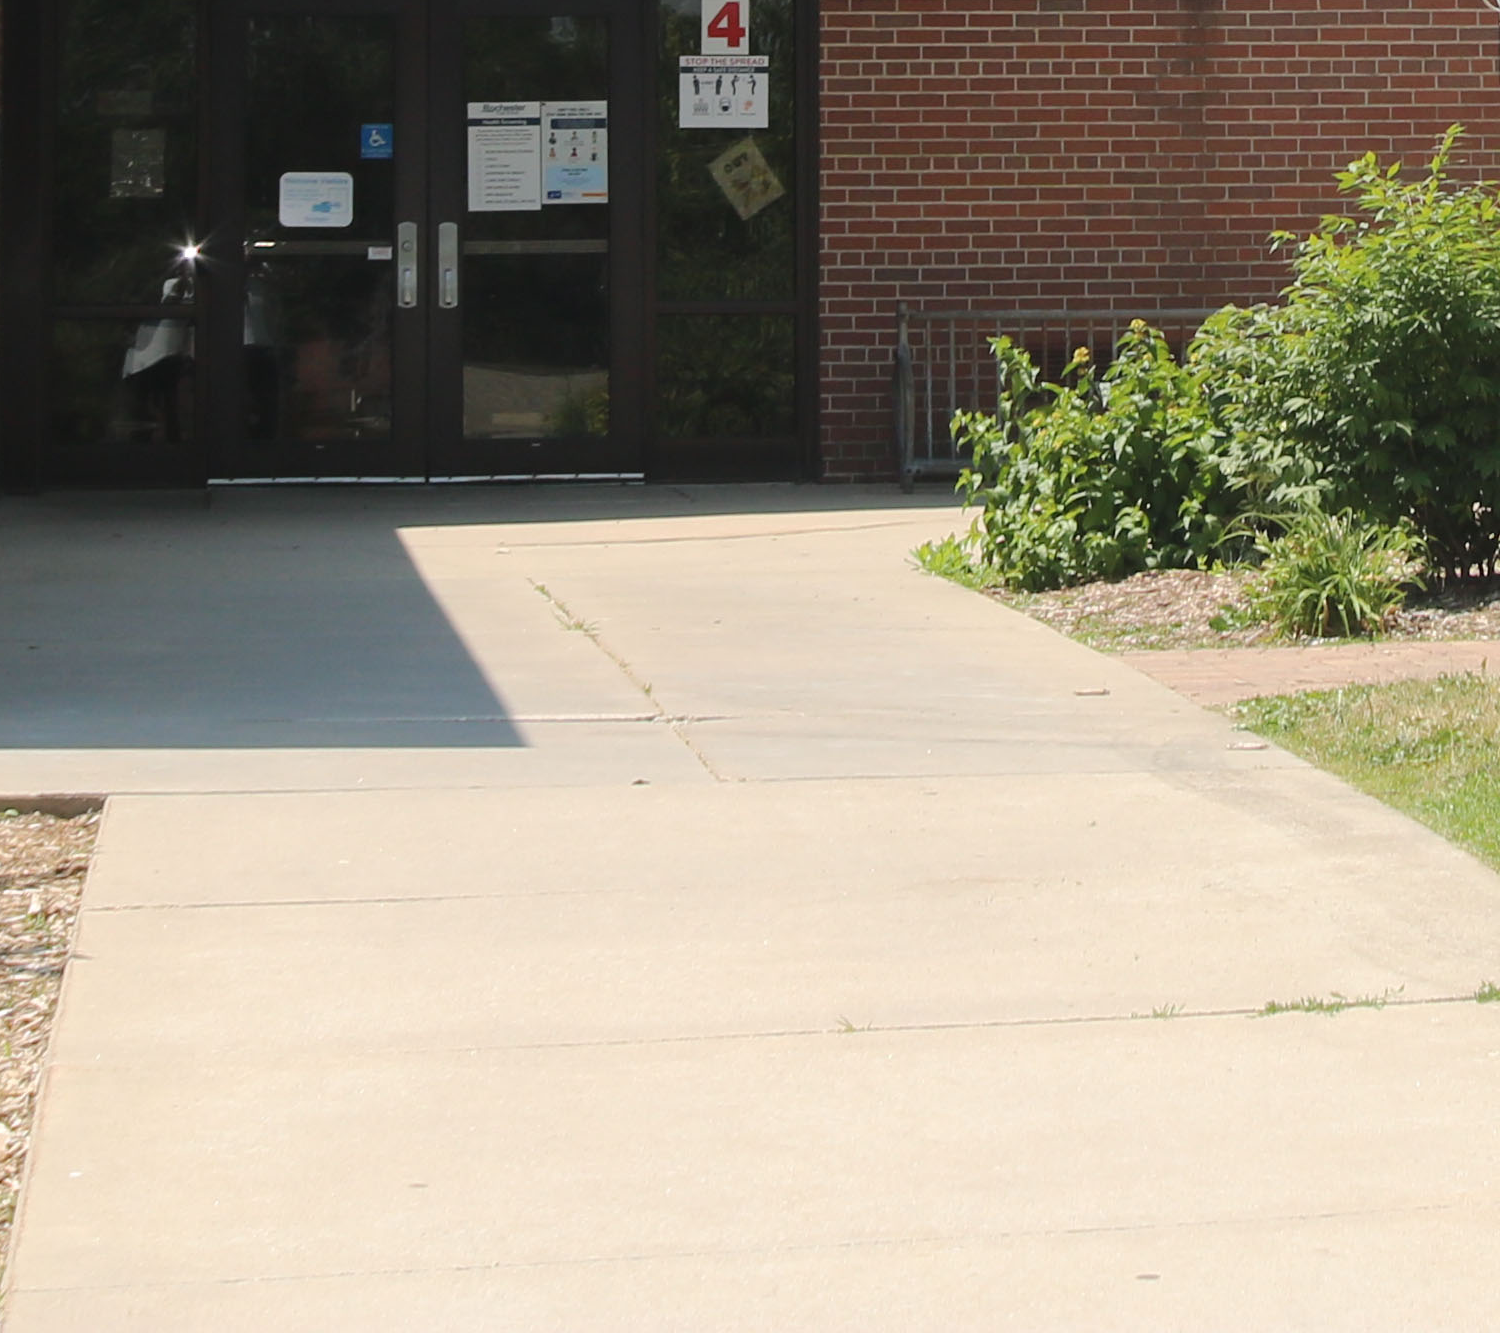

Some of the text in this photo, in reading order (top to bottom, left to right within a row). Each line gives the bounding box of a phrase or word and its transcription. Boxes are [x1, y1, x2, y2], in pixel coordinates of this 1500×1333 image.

[707, 1, 746, 48] 4
[685, 57, 765, 66] STOP THE SPREAD
[483, 104, 526, 112] Rochester
